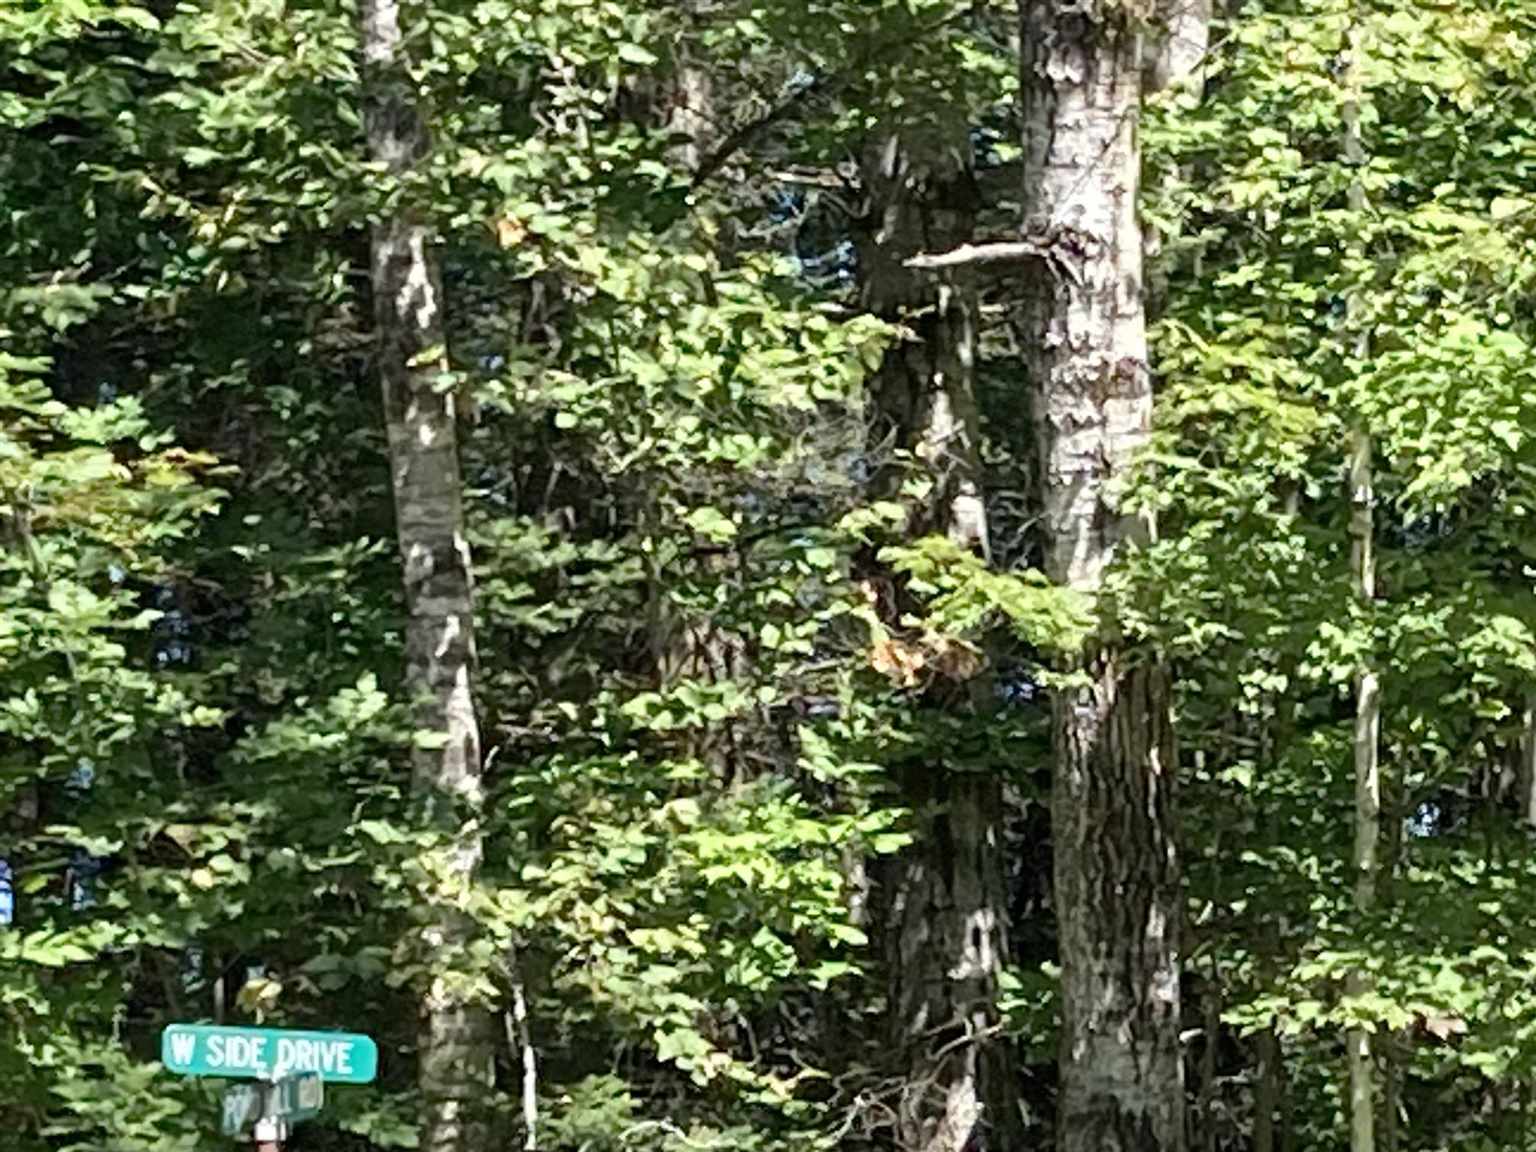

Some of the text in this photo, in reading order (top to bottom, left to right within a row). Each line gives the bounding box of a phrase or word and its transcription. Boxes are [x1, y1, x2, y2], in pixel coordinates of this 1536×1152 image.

[171, 1033, 354, 1075] W SIDE DRIVE
